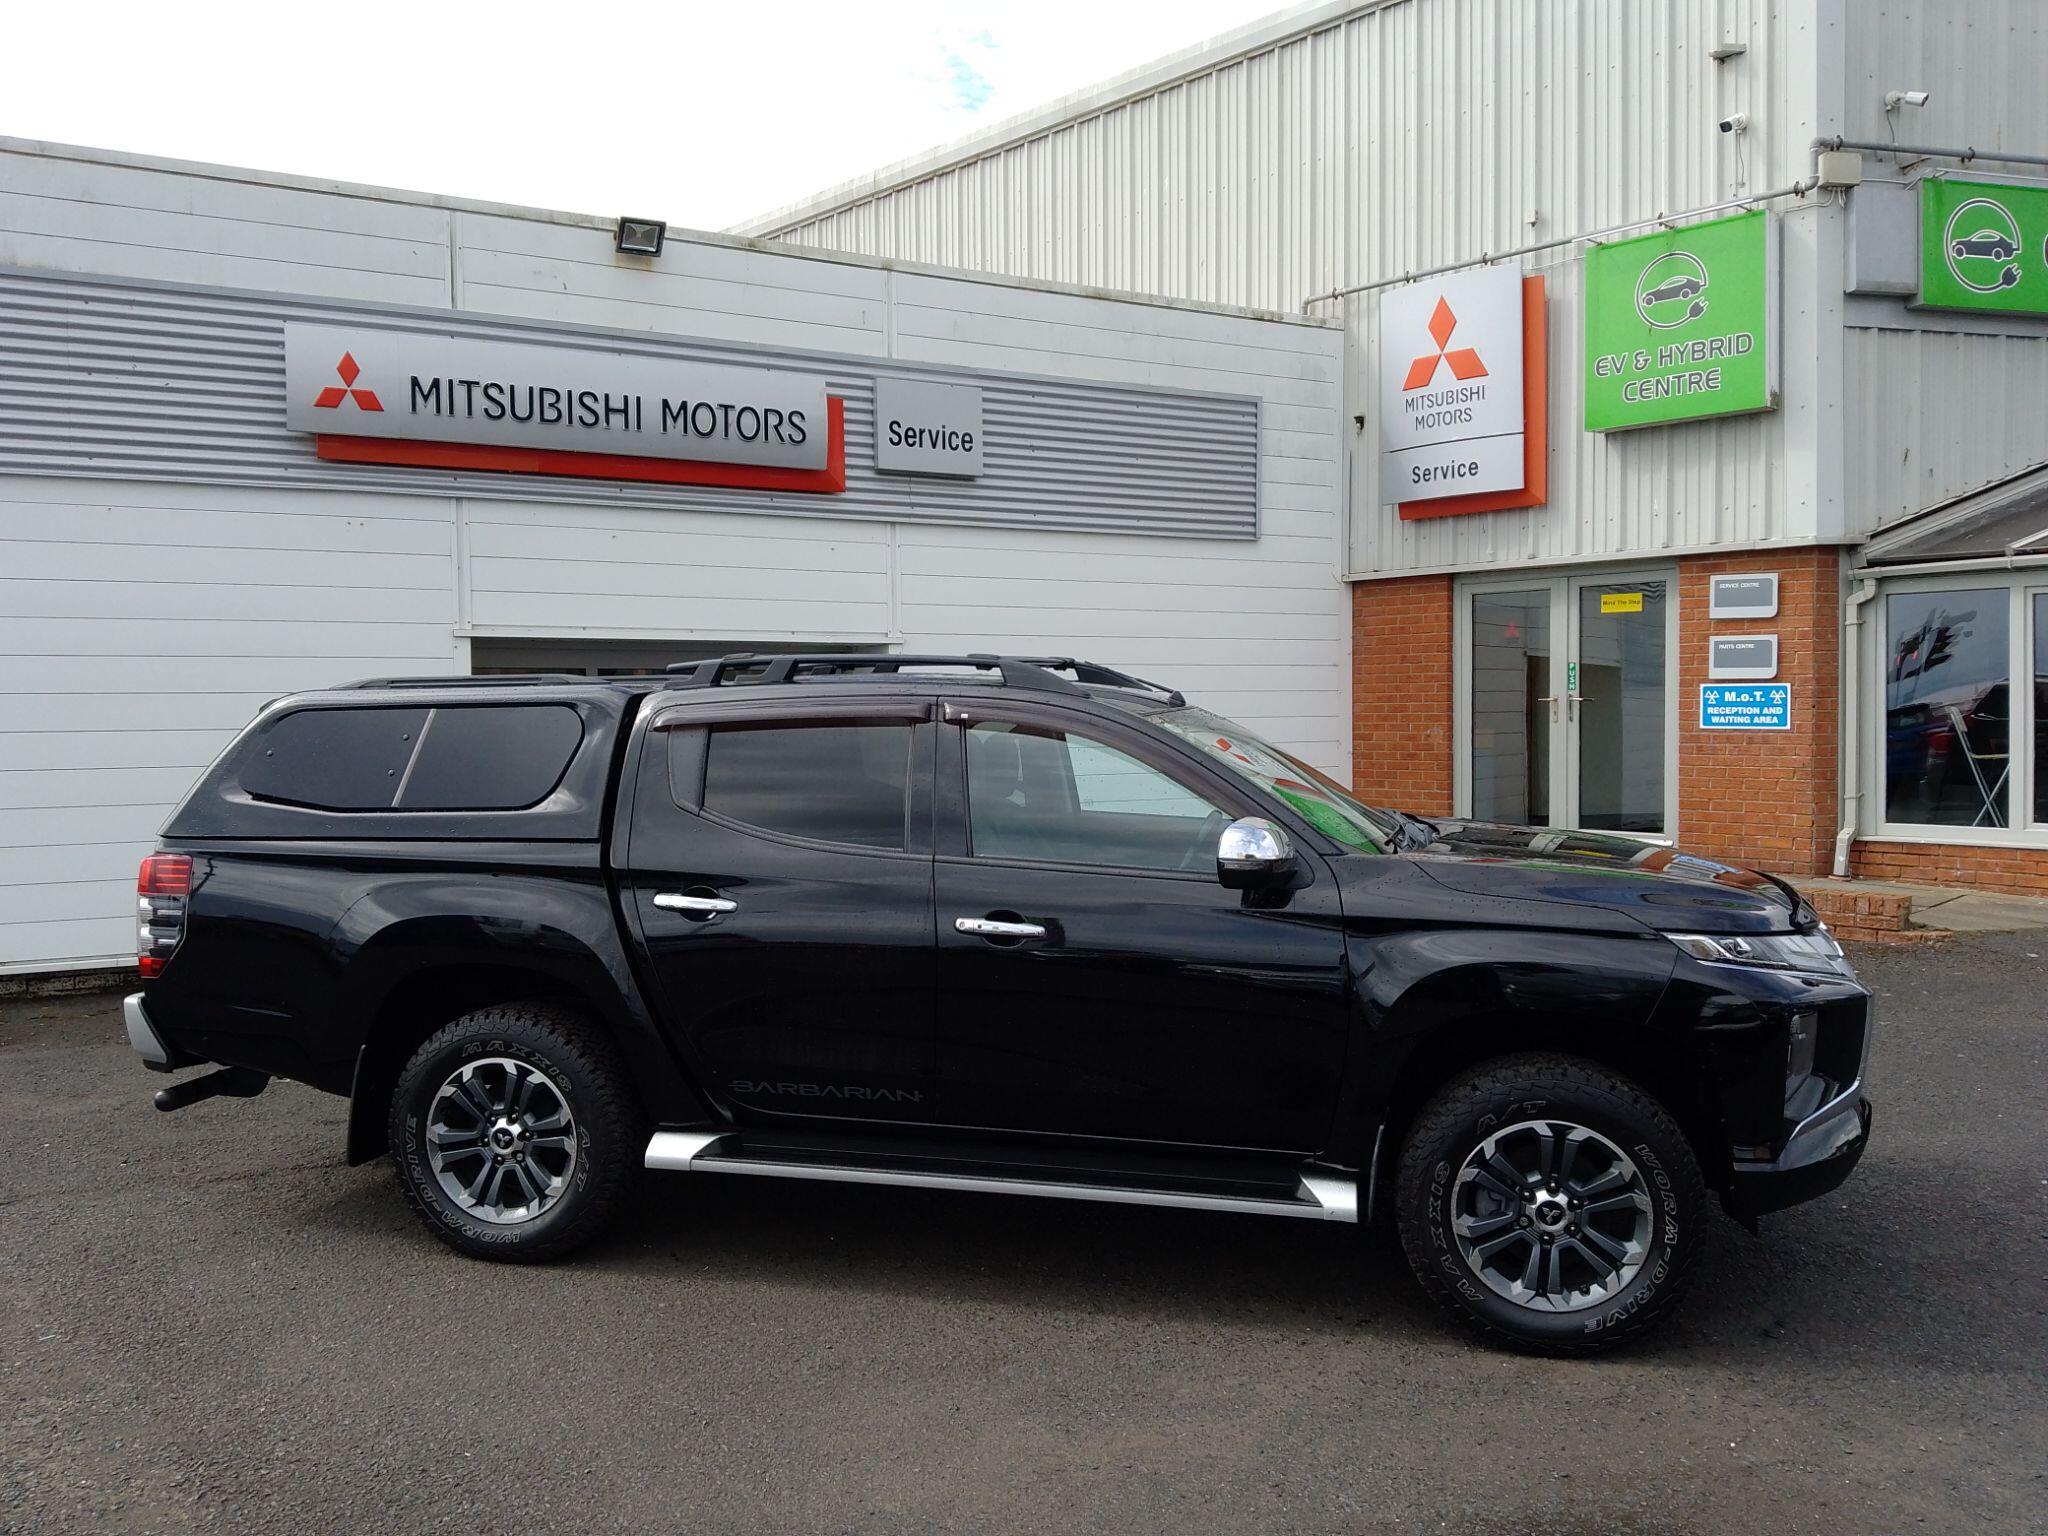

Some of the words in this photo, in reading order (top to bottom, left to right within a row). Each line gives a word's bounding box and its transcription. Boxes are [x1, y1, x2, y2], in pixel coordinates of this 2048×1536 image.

[1595, 350, 1628, 377] EV
[1633, 348, 1652, 370] &
[1657, 332, 1753, 369] HYBRID
[1405, 384, 1486, 414] MITSUBISHI
[1623, 367, 1722, 403] CENTRE
[409, 375, 643, 432] MITSUBISHI
[661, 399, 808, 445] MOTORS
[1415, 407, 1472, 432] MOTORS
[887, 420, 975, 453] Service
[1411, 459, 1479, 484] Service
[1724, 691, 1765, 702] M.o.T.
[461, 1040, 572, 1094] MAXXIS
[728, 1080, 924, 1103] BARBARIAN
[1429, 1160, 1485, 1301] MAXXIS
